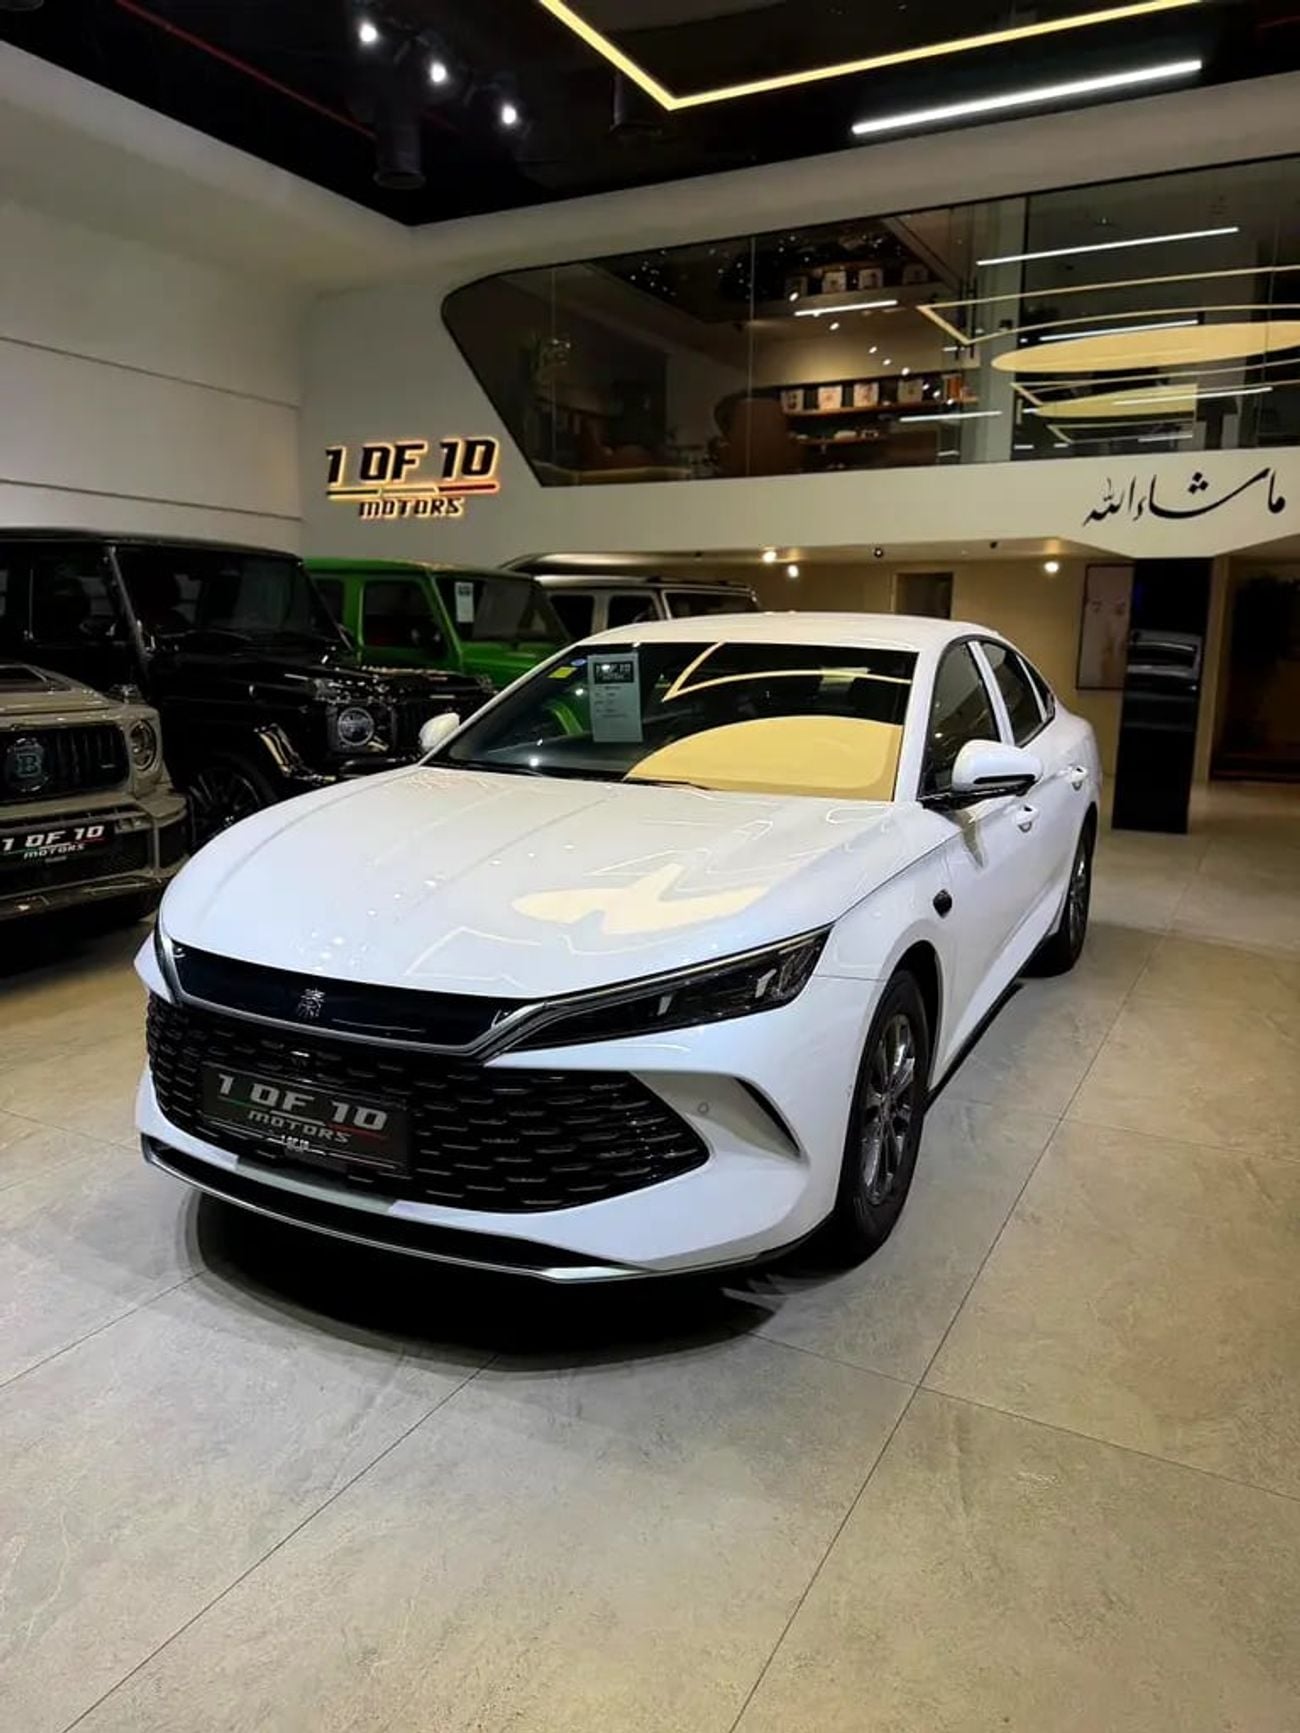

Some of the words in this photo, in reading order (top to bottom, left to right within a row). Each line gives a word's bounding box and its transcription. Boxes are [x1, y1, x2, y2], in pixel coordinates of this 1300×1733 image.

[325, 446, 346, 485] 1
[359, 442, 426, 483] OF
[439, 437, 498, 480] 10
[16, 752, 43, 778] B
[2, 838, 15, 851] 1
[25, 830, 66, 847] OF
[74, 825, 105, 840] 10
[218, 1073, 235, 1096] 1
[249, 1082, 315, 1111] OF
[331, 1100, 388, 1131] 10
